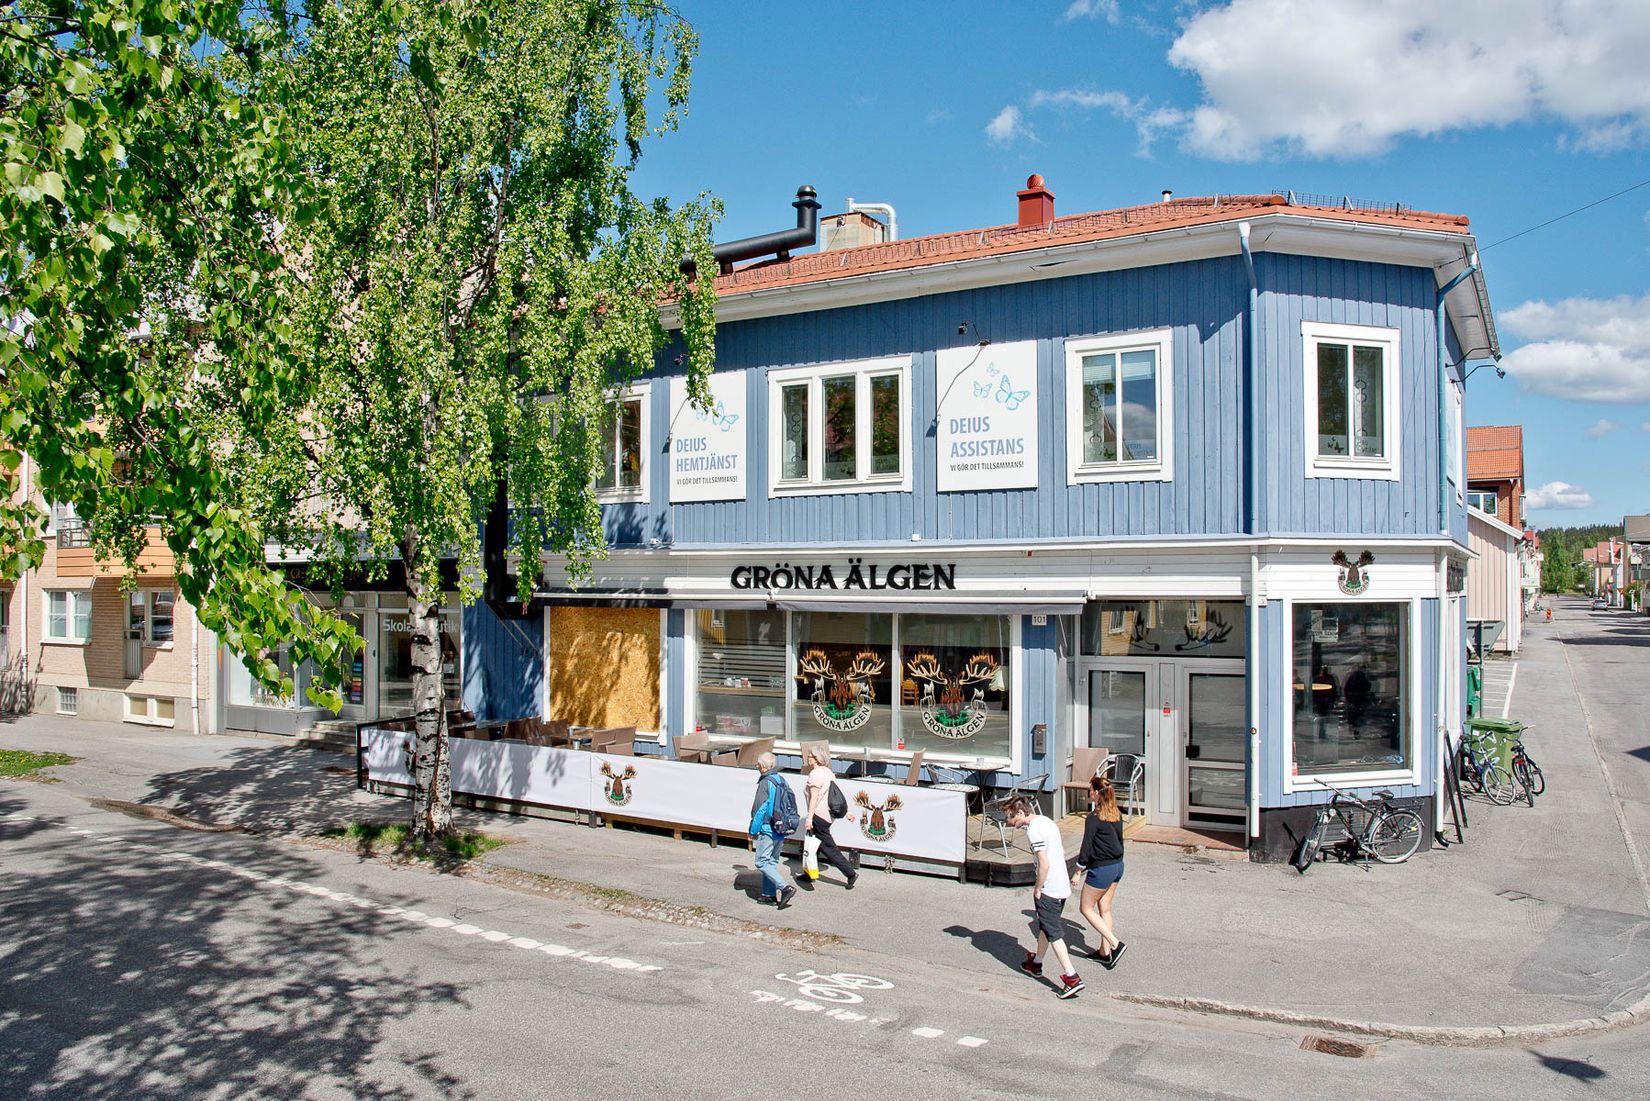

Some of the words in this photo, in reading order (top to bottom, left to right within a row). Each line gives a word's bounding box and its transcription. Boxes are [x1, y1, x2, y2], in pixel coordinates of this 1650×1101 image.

[950, 416, 990, 435] DEIUS
[676, 437, 707, 453] DEIUS
[950, 438, 1024, 458] ASSISTANS
[676, 453, 738, 472] HEMTJÄNST
[970, 463, 980, 471] DET
[981, 461, 1024, 470] TILLSAMMANS!
[702, 476, 738, 484] TILLSAMMANS!
[731, 562, 838, 589] GRÖNA
[843, 557, 957, 590] ÄLGEN
[383, 618, 412, 632] Skola
[1033, 615, 1046, 624] 101
[813, 705, 841, 730] GRÖNA
[843, 706, 870, 730] ÄLGEN
[923, 711, 953, 737] GRÖNA
[955, 713, 985, 737] ÄLGEN
